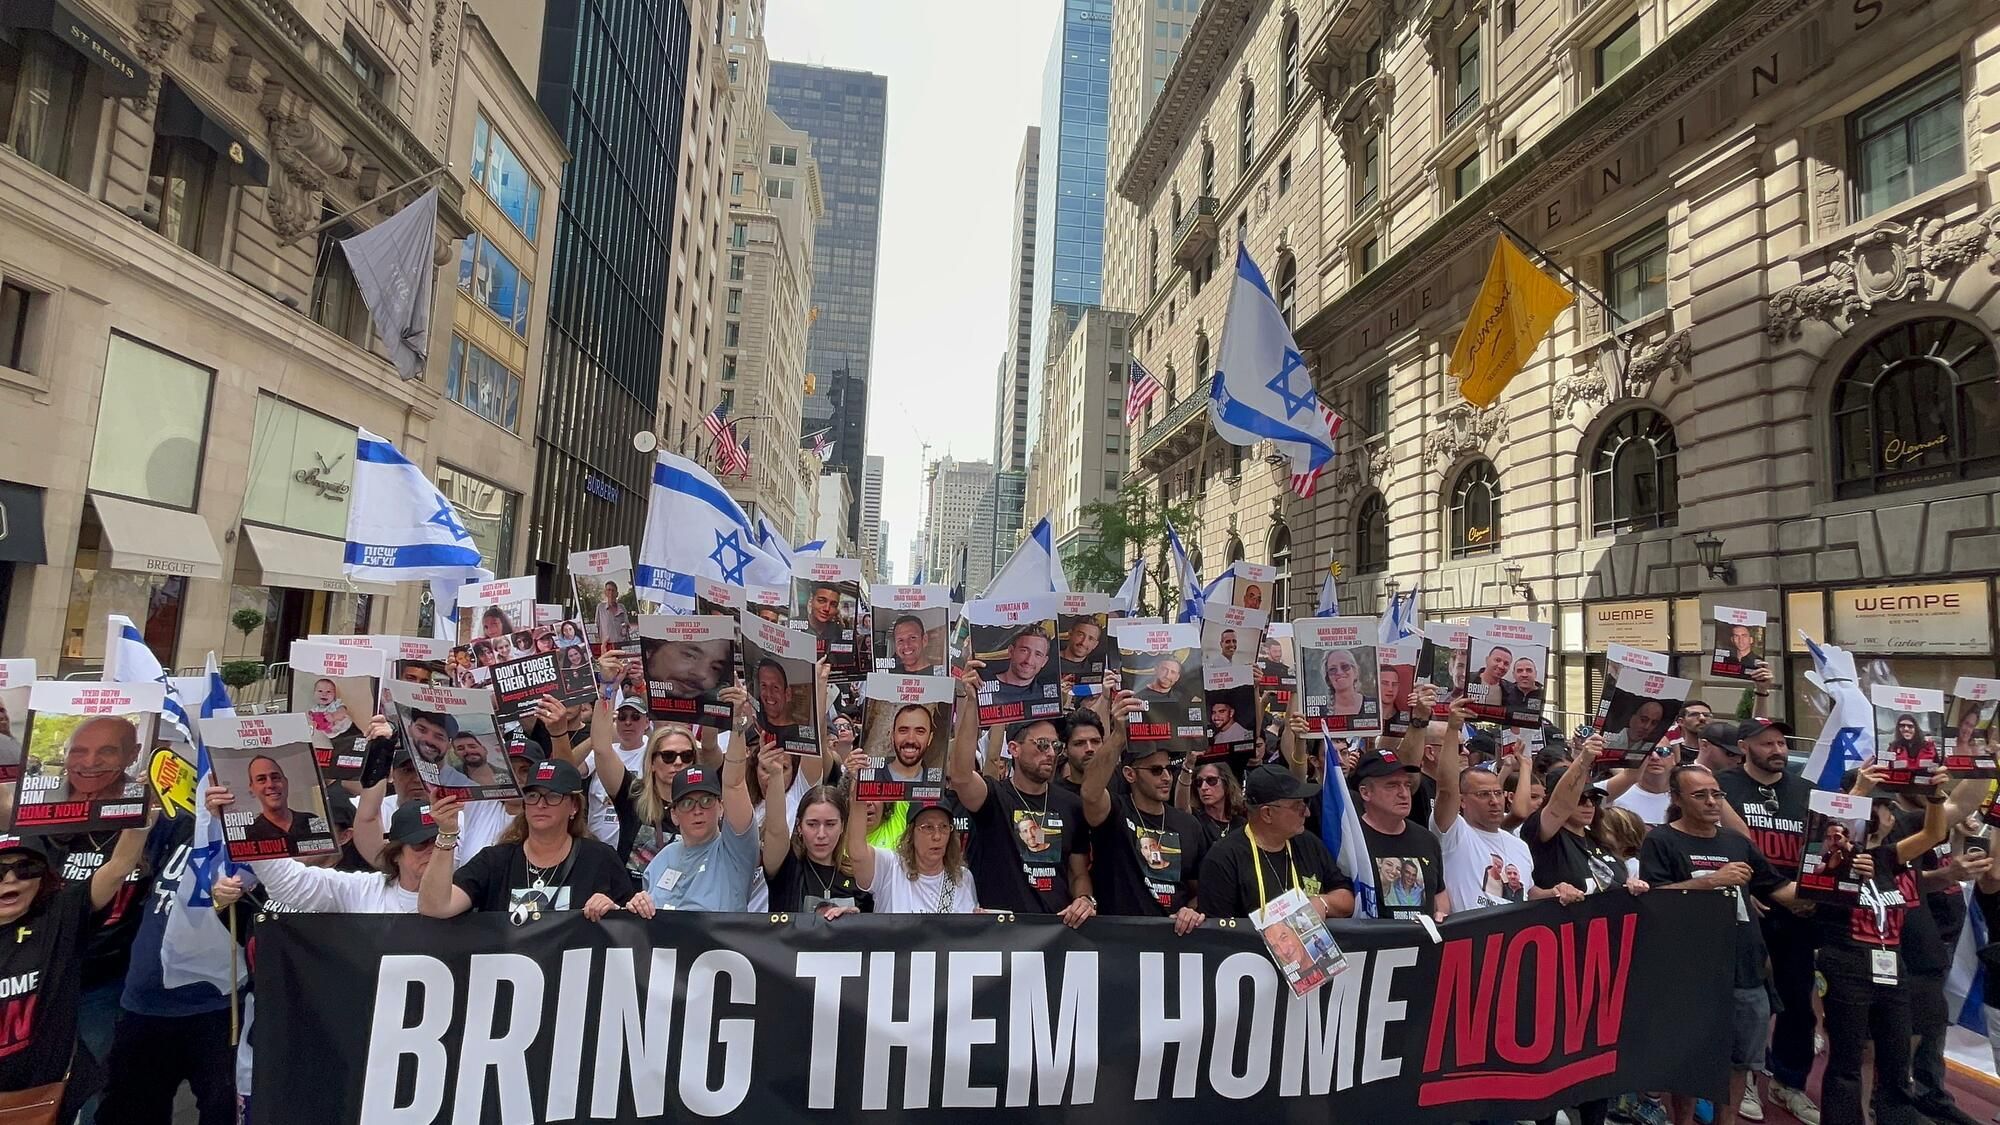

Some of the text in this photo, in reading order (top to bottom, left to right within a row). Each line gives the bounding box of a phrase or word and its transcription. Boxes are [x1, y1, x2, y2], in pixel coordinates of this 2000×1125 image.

[70, 24, 135, 80] ST REGIS
[1361, 287, 1432, 348] THE
[1884, 434, 1948, 464] Clement
[586, 474, 620, 504] BURBERRY
[146, 558, 196, 575] BREGUET
[1854, 594, 1960, 611] WEMPE
[1598, 609, 1654, 621] WEMPE
[1887, 636, 1927, 648] Cartier
[495, 655, 554, 681] DON'T FORGET
[876, 658, 896, 668] BRING
[498, 668, 557, 693] THEIR FACES
[650, 681, 673, 690] BRING
[1468, 682, 1489, 694] BRING
[650, 689, 666, 698] HIM
[978, 694, 993, 706] HIM
[1306, 696, 1326, 706] BRING
[72, 698, 131, 706] SHLOMO MANTZUR
[980, 705, 1001, 718] HOME
[1002, 701, 1025, 716] NOW!
[1306, 706, 1320, 717] HER
[237, 728, 258, 738] TSACHI
[1130, 724, 1150, 736] HOME
[1150, 722, 1172, 736] NOW!
[418, 763, 440, 775] BRING
[860, 768, 876, 781] HIM
[22, 776, 60, 791] BRING
[858, 782, 905, 796] HOME NOW!
[20, 790, 46, 805] HIM
[16, 806, 53, 820] HOME
[53, 801, 90, 818] NOW!
[224, 812, 254, 827] BRING
[1745, 814, 1804, 833] THEM HOME
[226, 826, 246, 841] HIM
[229, 841, 258, 856] HOME
[258, 838, 288, 854] NOW!
[64, 852, 105, 868] BRING
[0, 970, 40, 998] OME
[358, 912, 1638, 1125] BRING THEM HOME NOW
